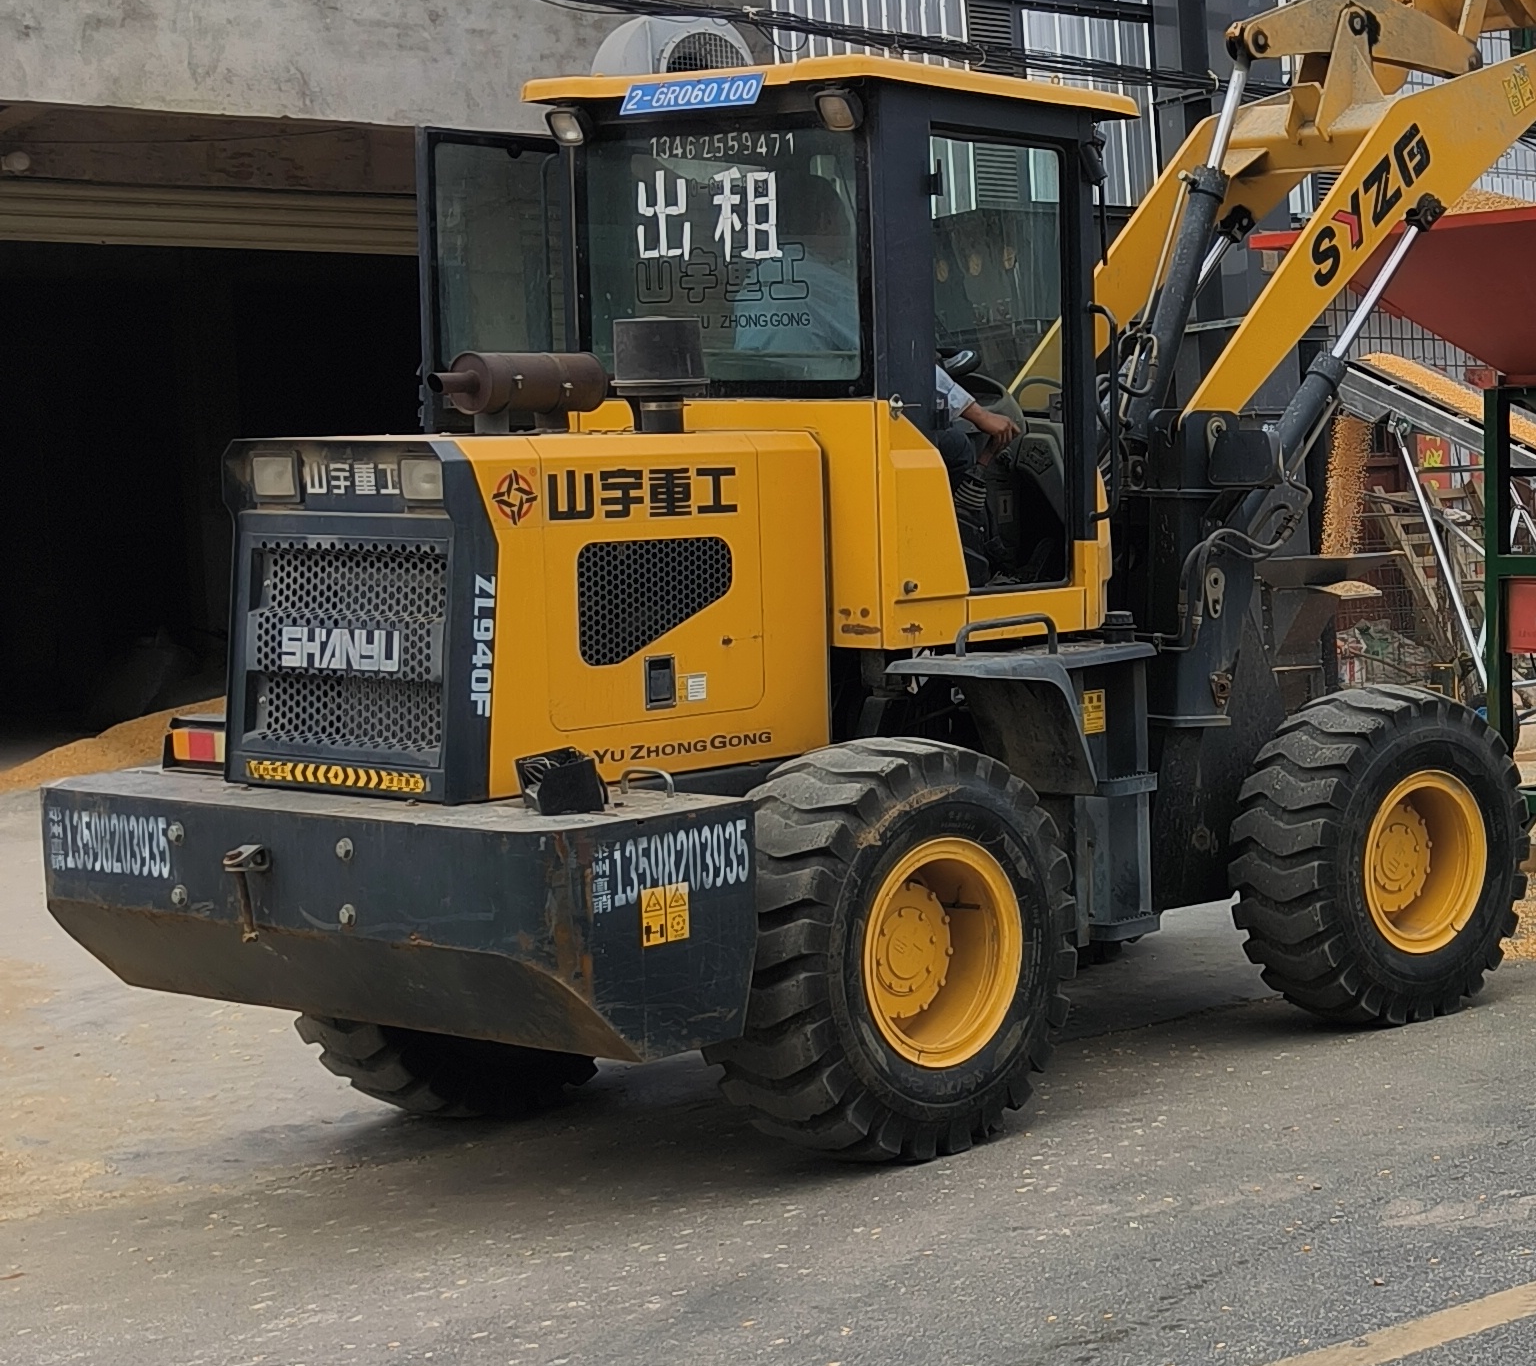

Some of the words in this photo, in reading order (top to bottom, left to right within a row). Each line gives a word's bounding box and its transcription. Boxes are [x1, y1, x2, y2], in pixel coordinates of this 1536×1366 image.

[650, 131, 795, 159] 13462559471
[636, 166, 783, 262] 出租
[1311, 123, 1432, 288] SYZG
[636, 242, 810, 304] 山宇重工
[306, 461, 400, 495] 山宇重工
[547, 467, 739, 522] 山宇重工
[281, 626, 400, 672] SHANYU
[471, 573, 496, 718] ZL940F
[65, 809, 170, 879] 13598203935
[614, 818, 749, 908] 13598203935
